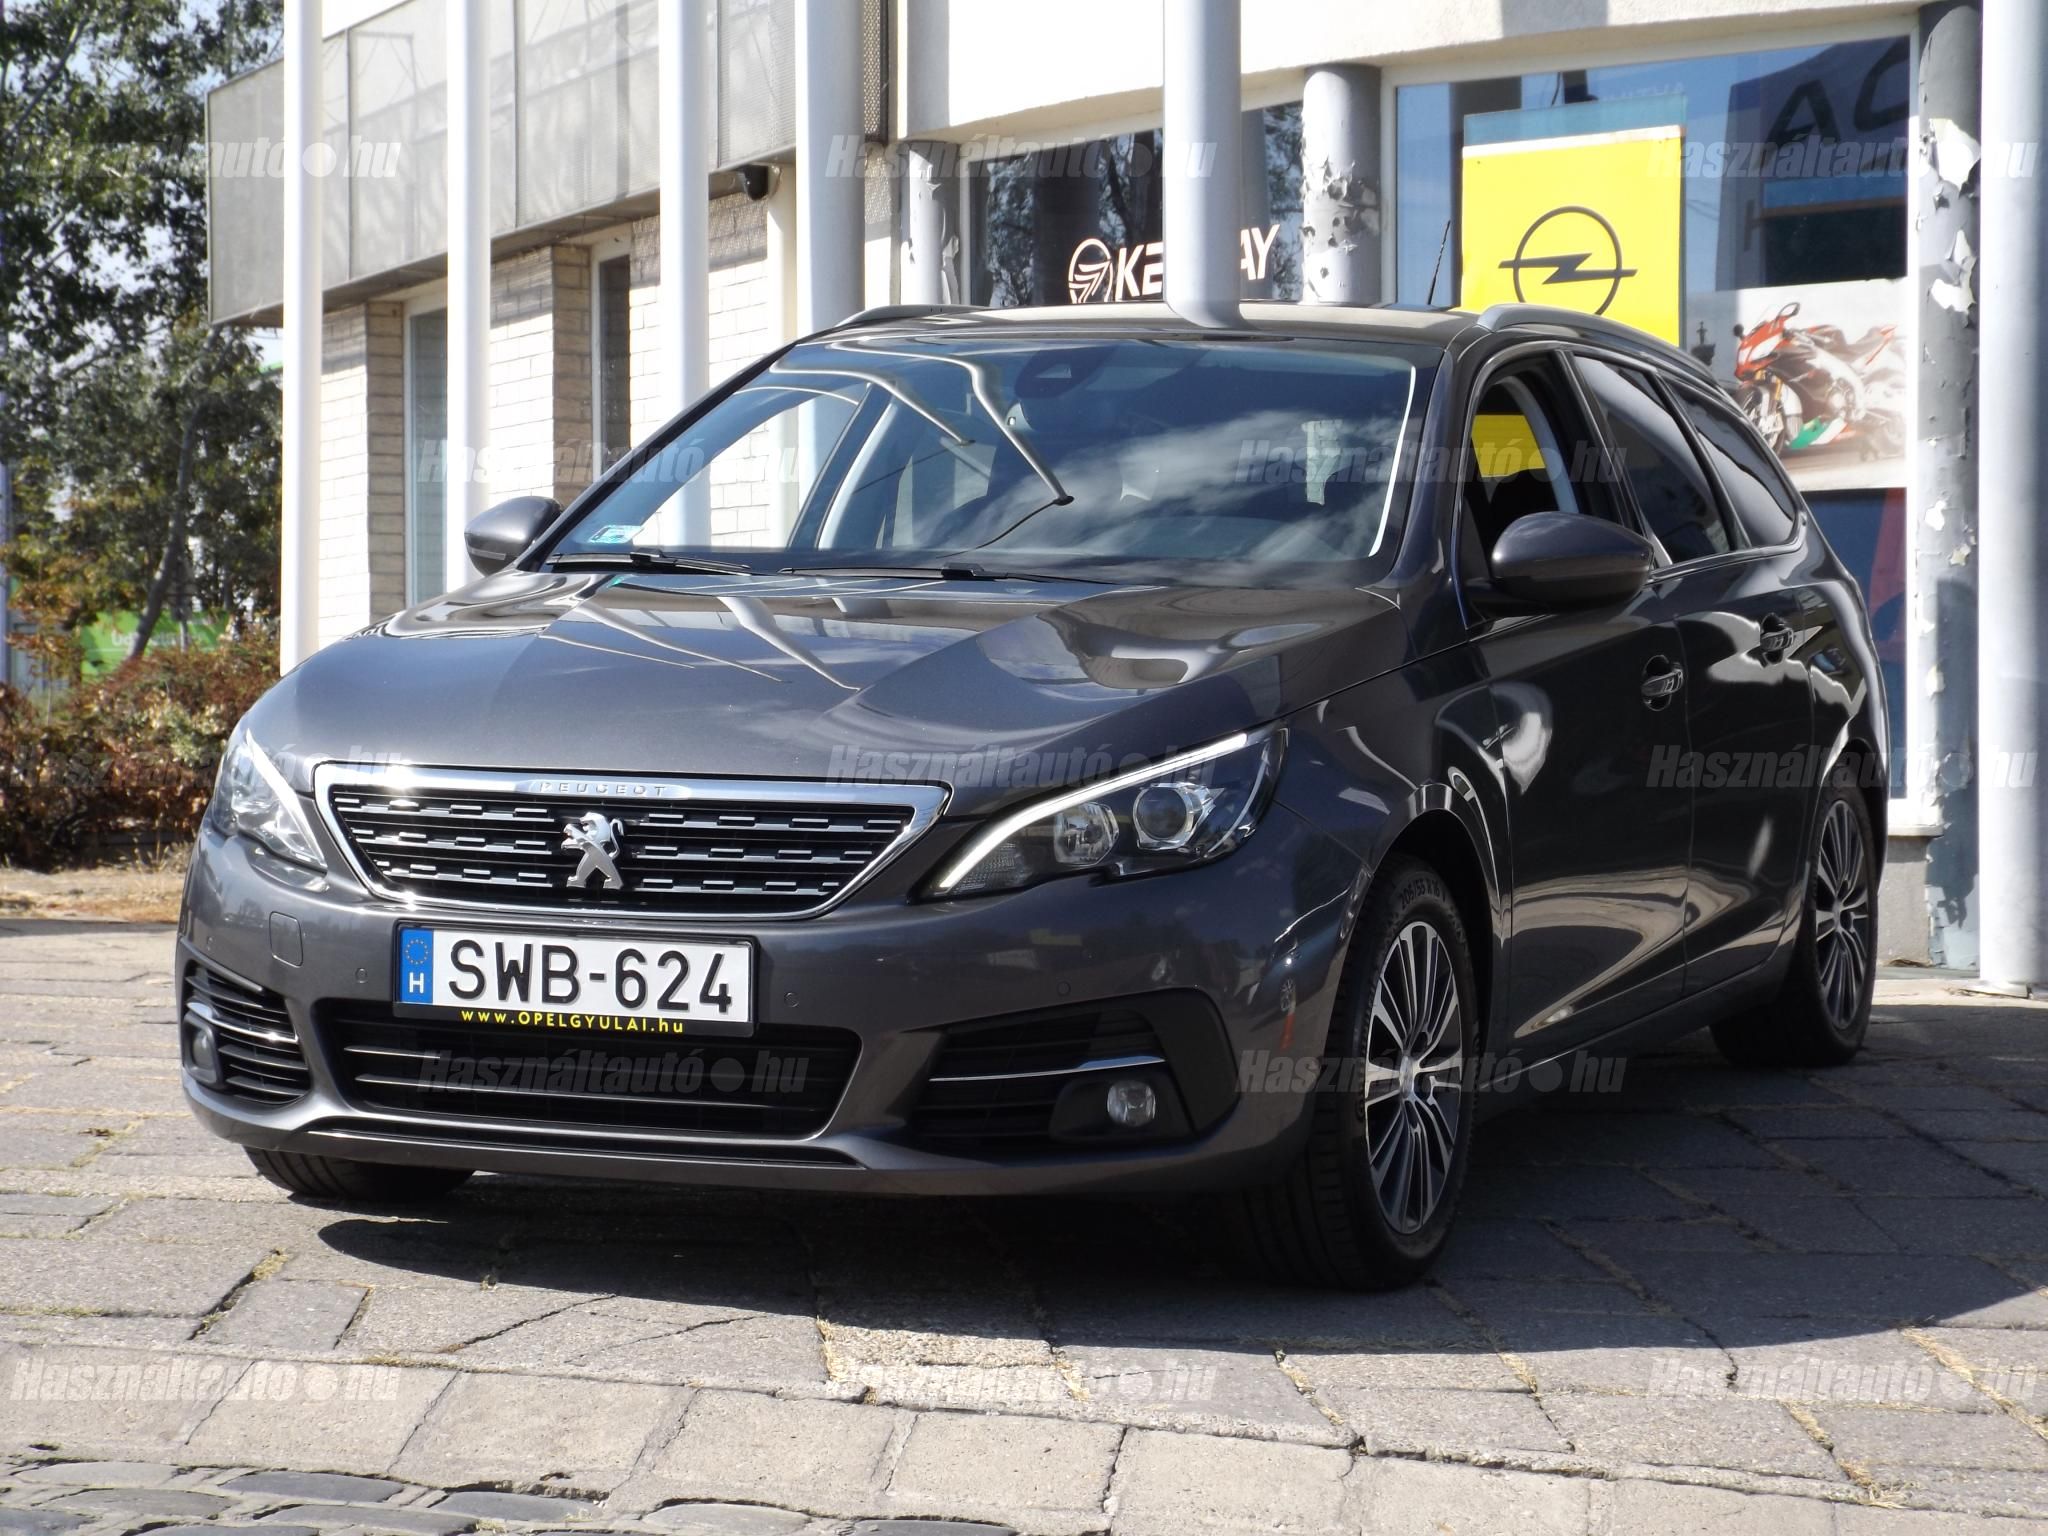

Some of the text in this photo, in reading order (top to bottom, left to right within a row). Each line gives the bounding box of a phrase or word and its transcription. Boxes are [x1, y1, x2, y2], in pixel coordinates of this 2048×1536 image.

[1115, 223, 1281, 303] KEAY
[540, 782, 666, 797] PEUGEOT
[408, 938, 732, 1014] H SWB-624
[461, 1010, 684, 1033] www.OPELGYULAI.hu
